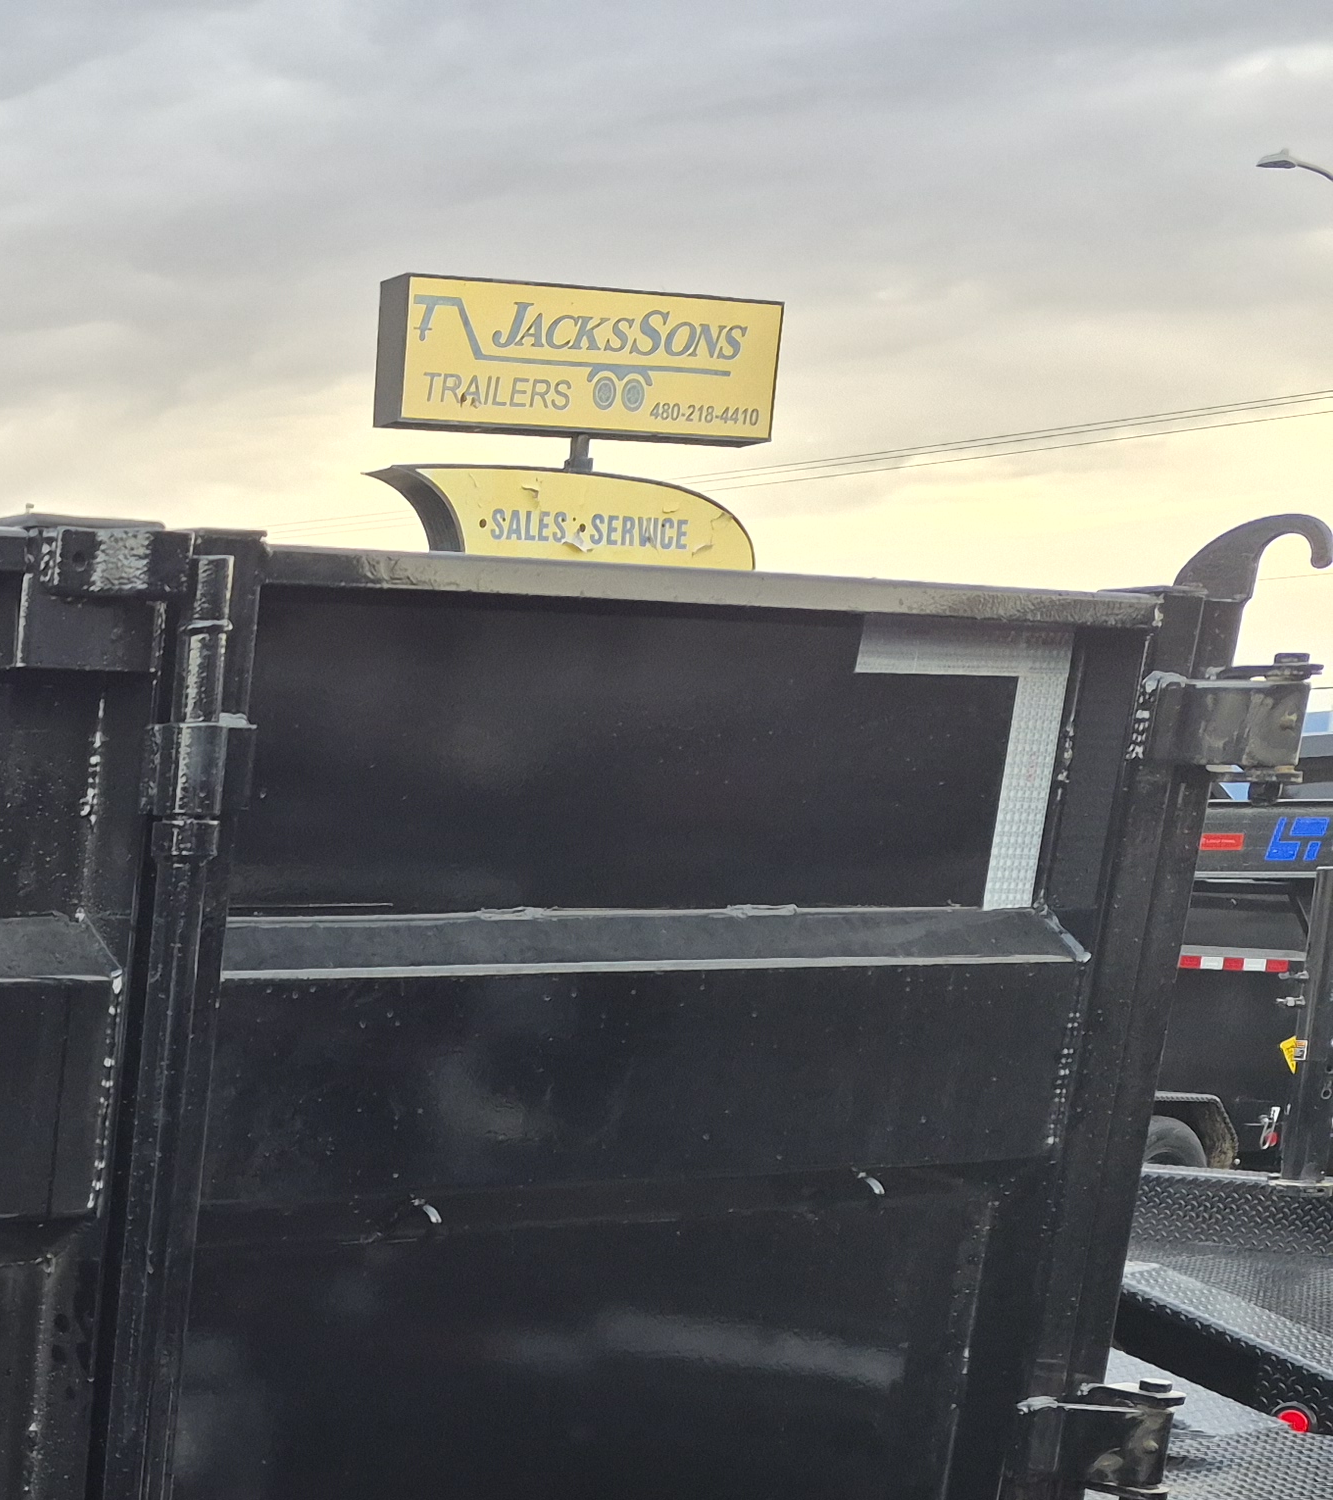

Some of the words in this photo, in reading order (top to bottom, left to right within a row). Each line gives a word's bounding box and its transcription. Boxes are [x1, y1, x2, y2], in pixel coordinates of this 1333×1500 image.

[423, 371, 572, 411] TRAILERS
[649, 401, 760, 427] 480-218-4410
[490, 508, 567, 543] SALES
[589, 513, 689, 550] SERVICE
